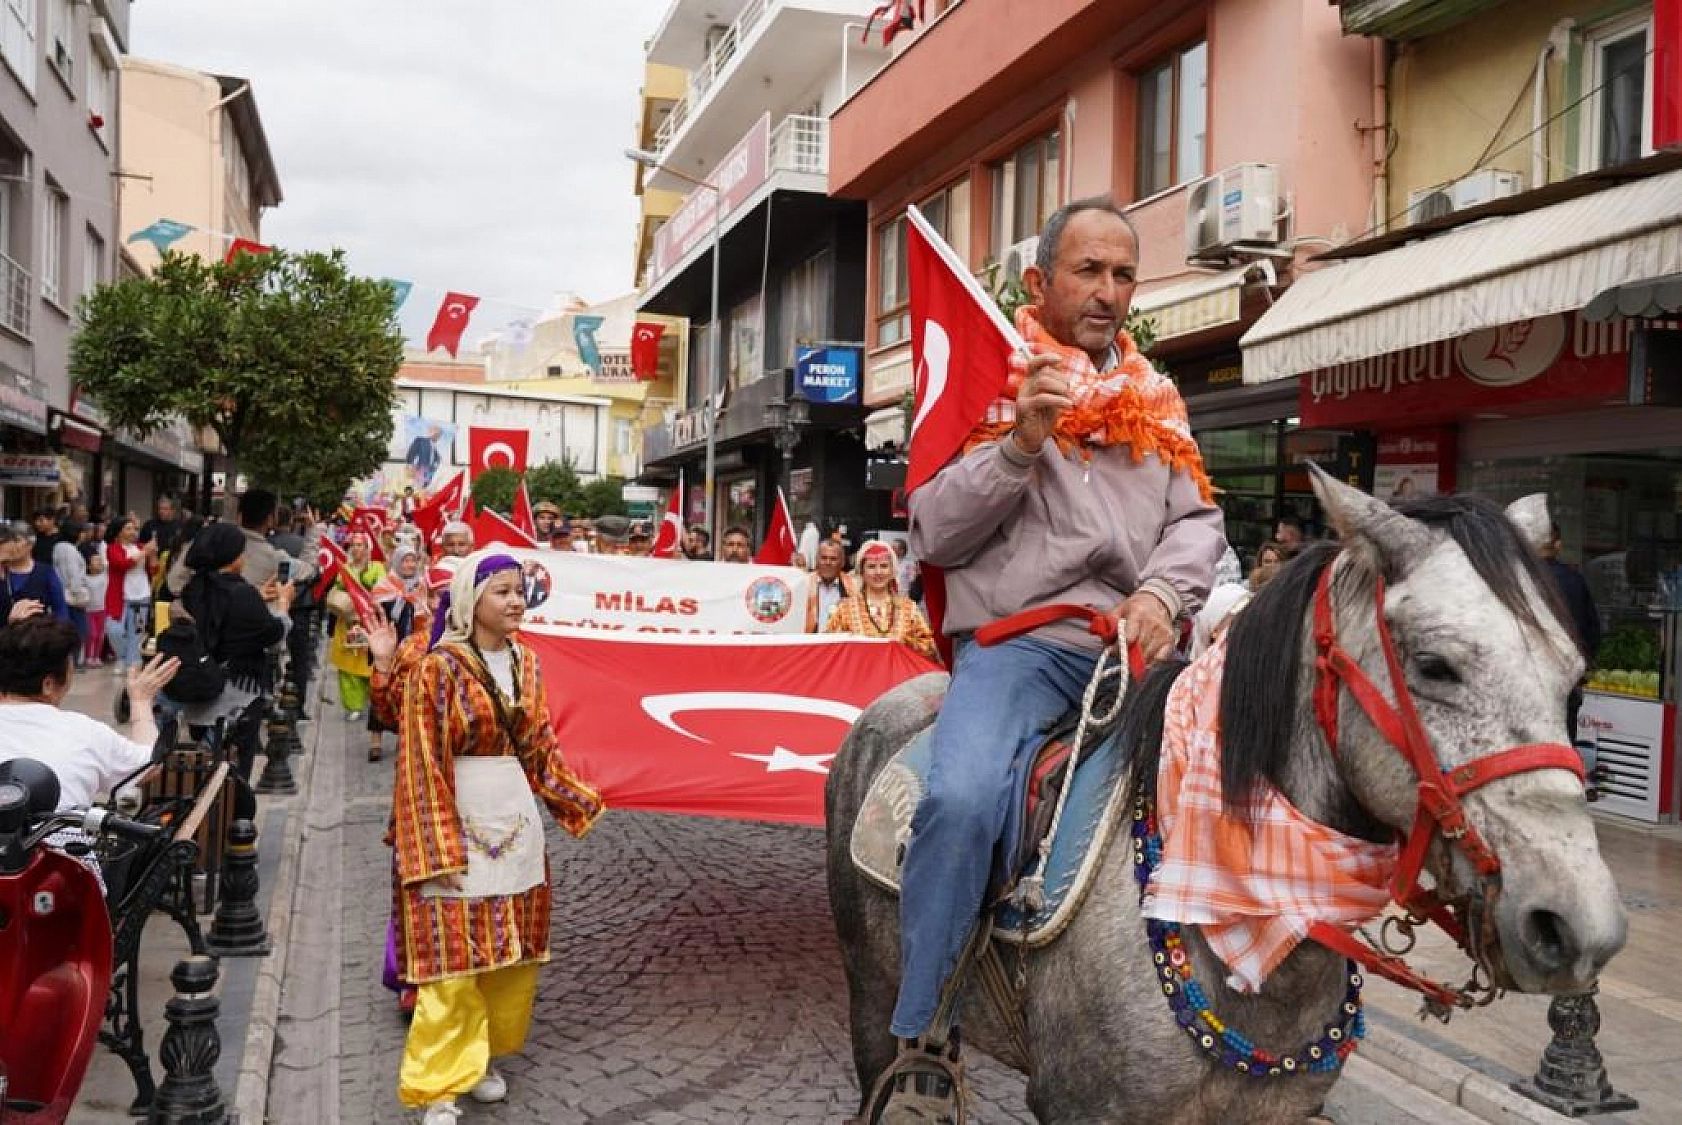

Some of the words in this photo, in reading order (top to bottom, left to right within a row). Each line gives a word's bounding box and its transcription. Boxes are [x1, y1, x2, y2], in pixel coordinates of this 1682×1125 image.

[808, 363, 846, 375] PERON
[803, 376, 851, 388] MARKET
[595, 591, 699, 616] MİLAS
